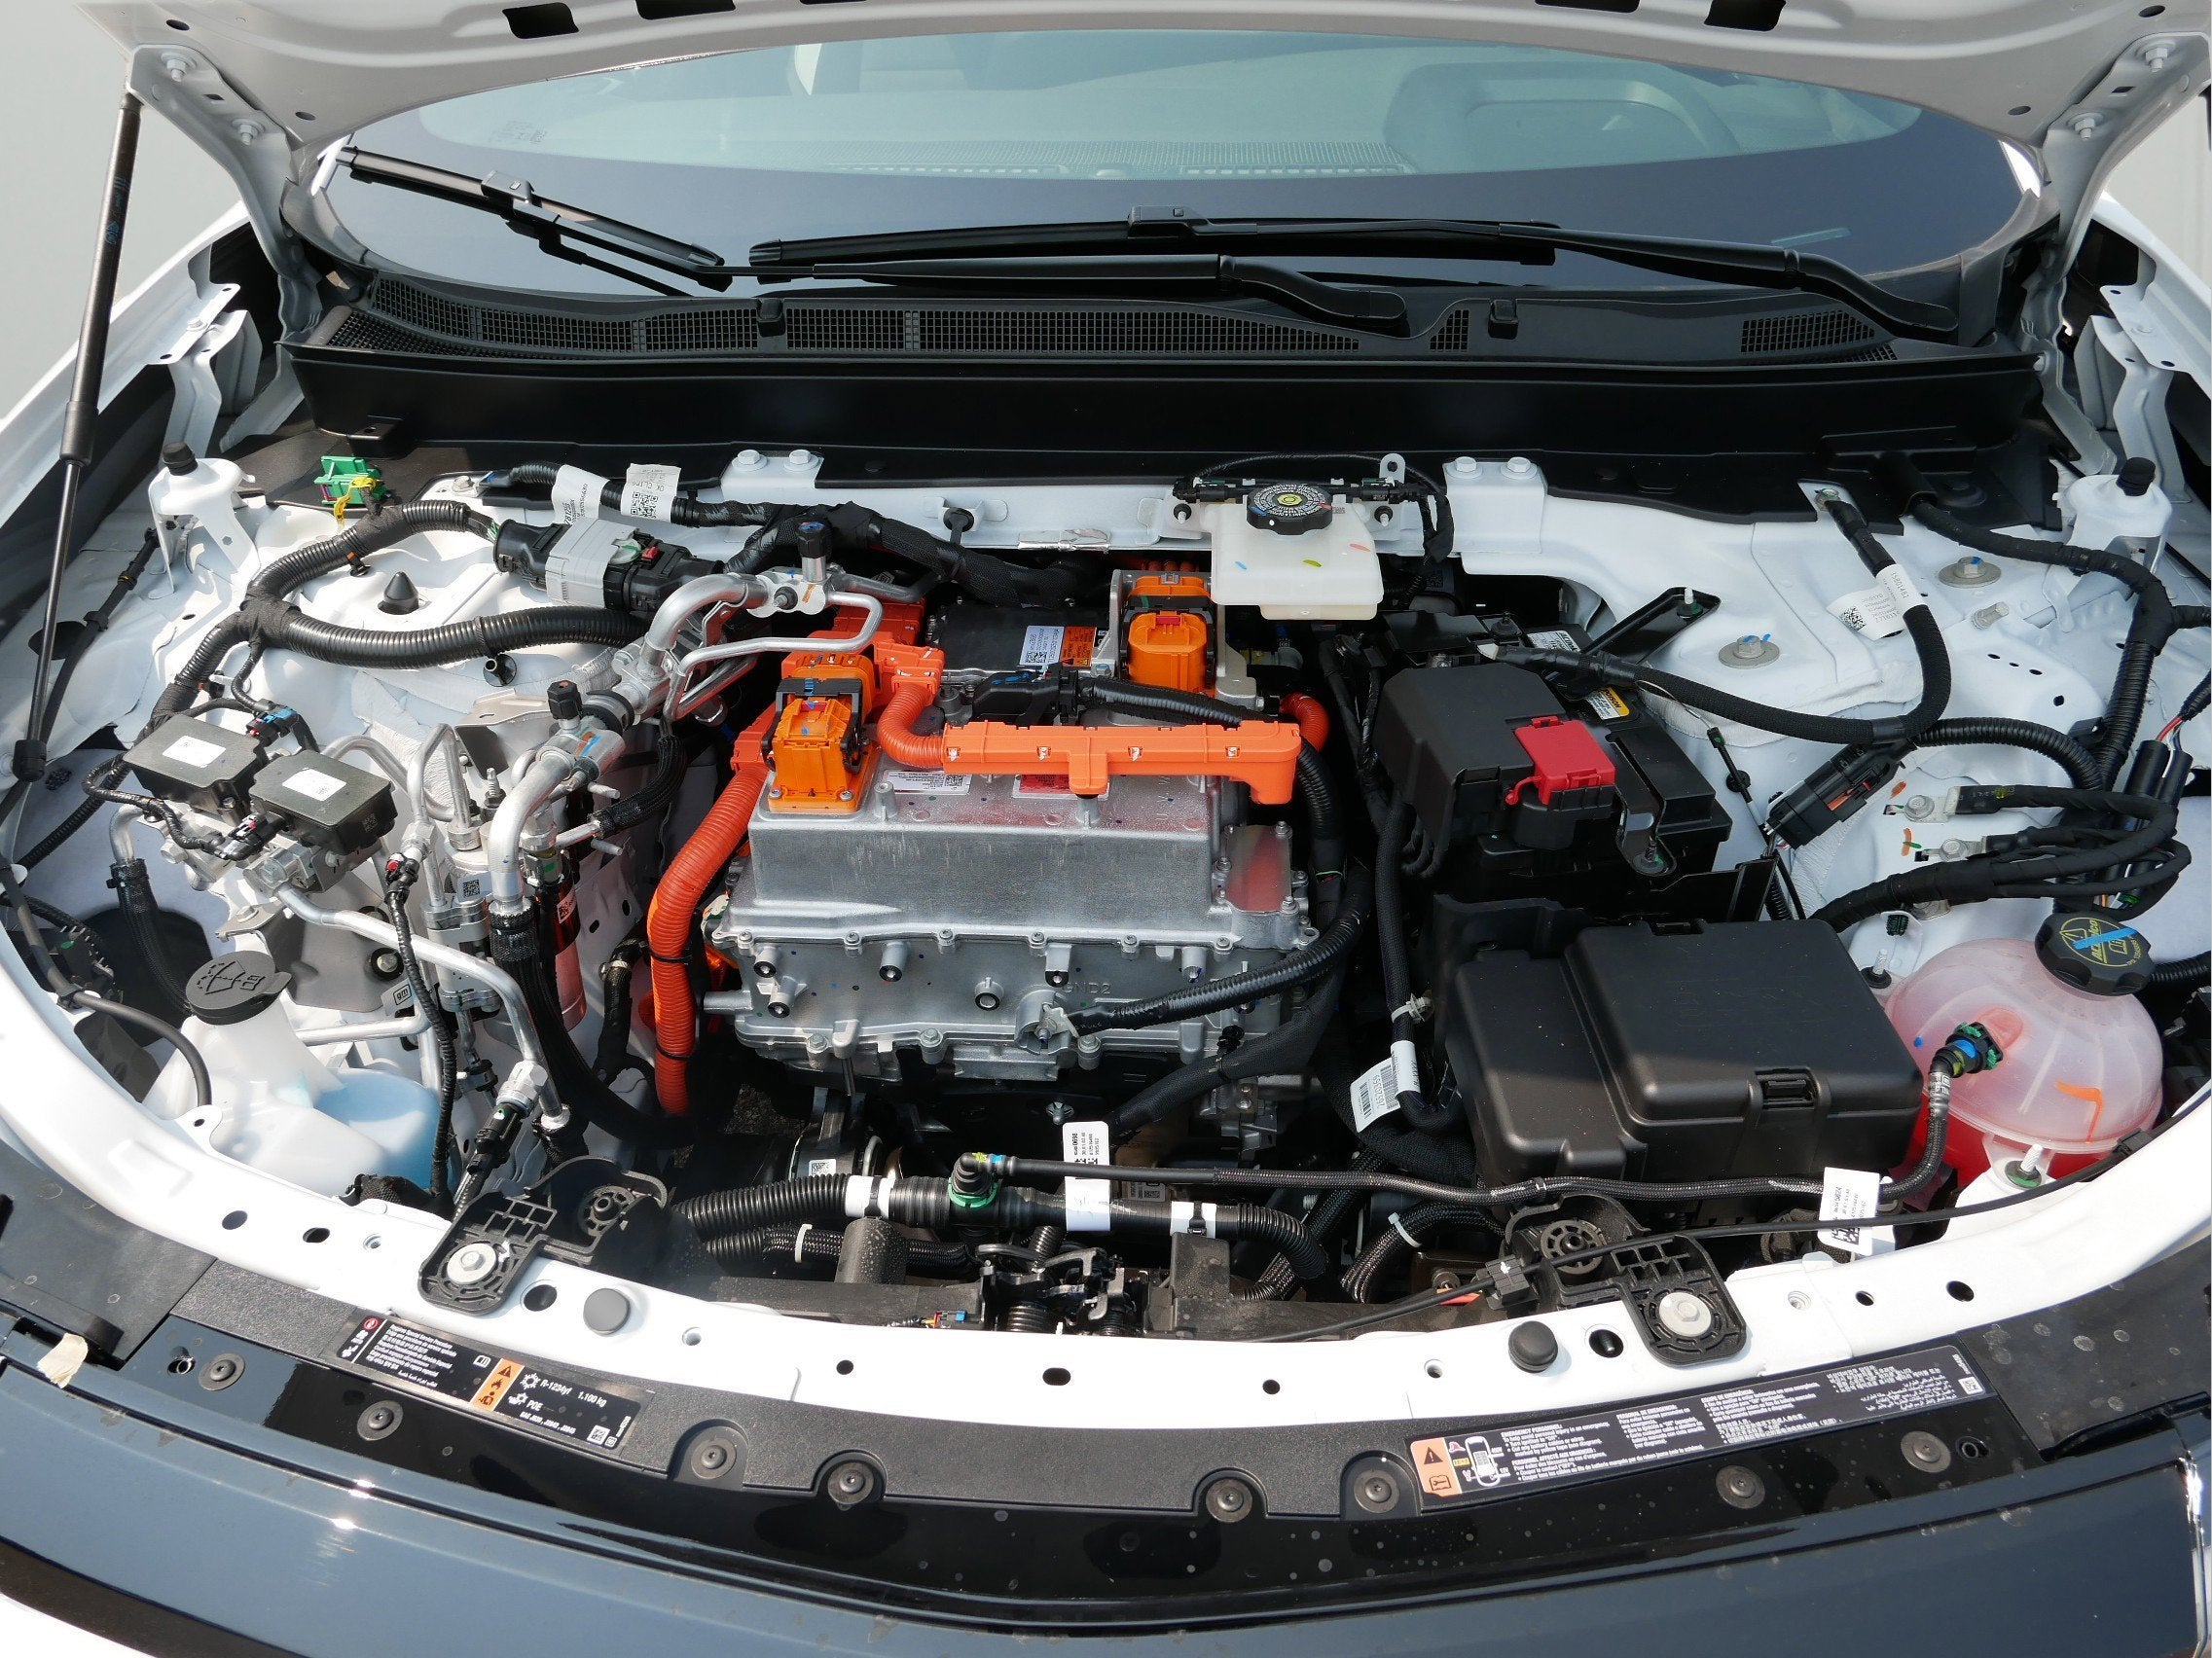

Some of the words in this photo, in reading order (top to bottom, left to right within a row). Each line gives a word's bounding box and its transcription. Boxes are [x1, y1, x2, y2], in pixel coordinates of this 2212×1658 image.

[540, 1380, 572, 1395] R-1234yf
[578, 1391, 598, 1403] 1.100
[596, 1397, 607, 1408] kg
[526, 1400, 543, 1411] POE
